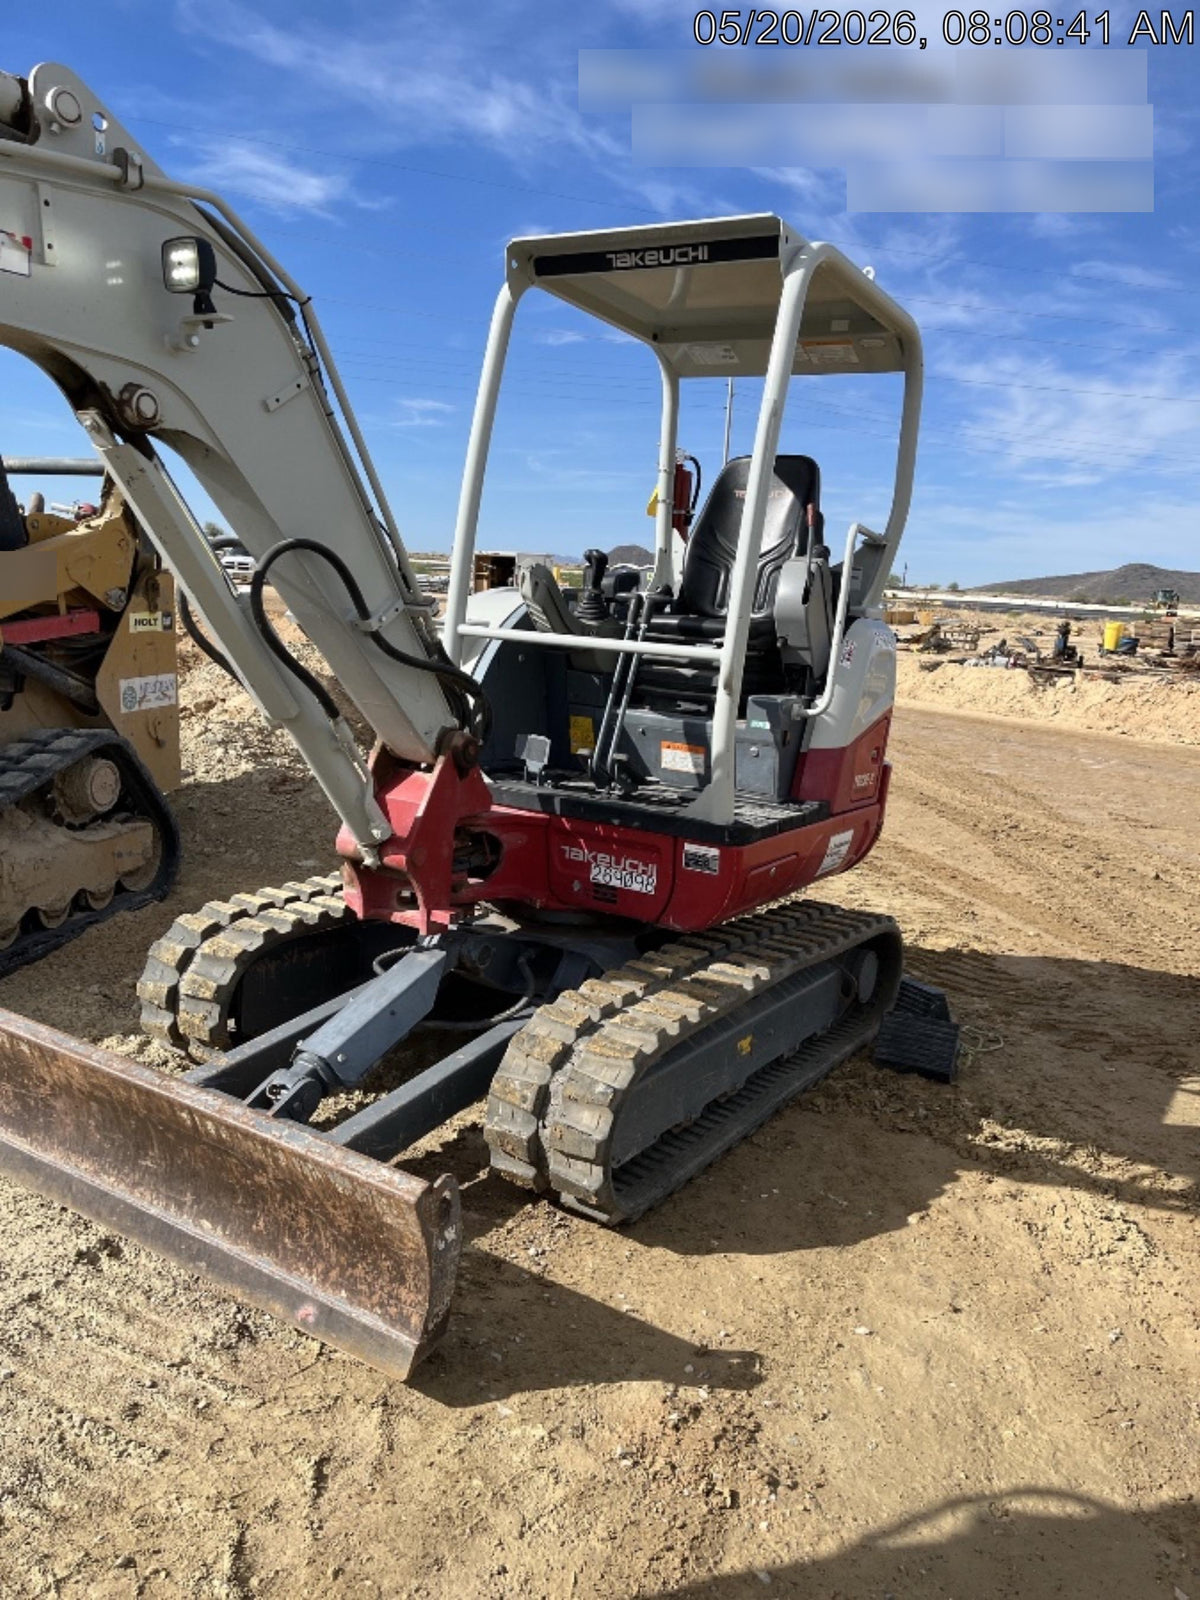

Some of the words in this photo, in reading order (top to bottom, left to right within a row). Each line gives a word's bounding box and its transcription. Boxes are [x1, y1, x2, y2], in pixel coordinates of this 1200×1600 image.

[605, 245, 709, 269] TAKEUCHI
[134, 618, 159, 627] HOLT
[560, 845, 657, 878] TAKEUCHI
